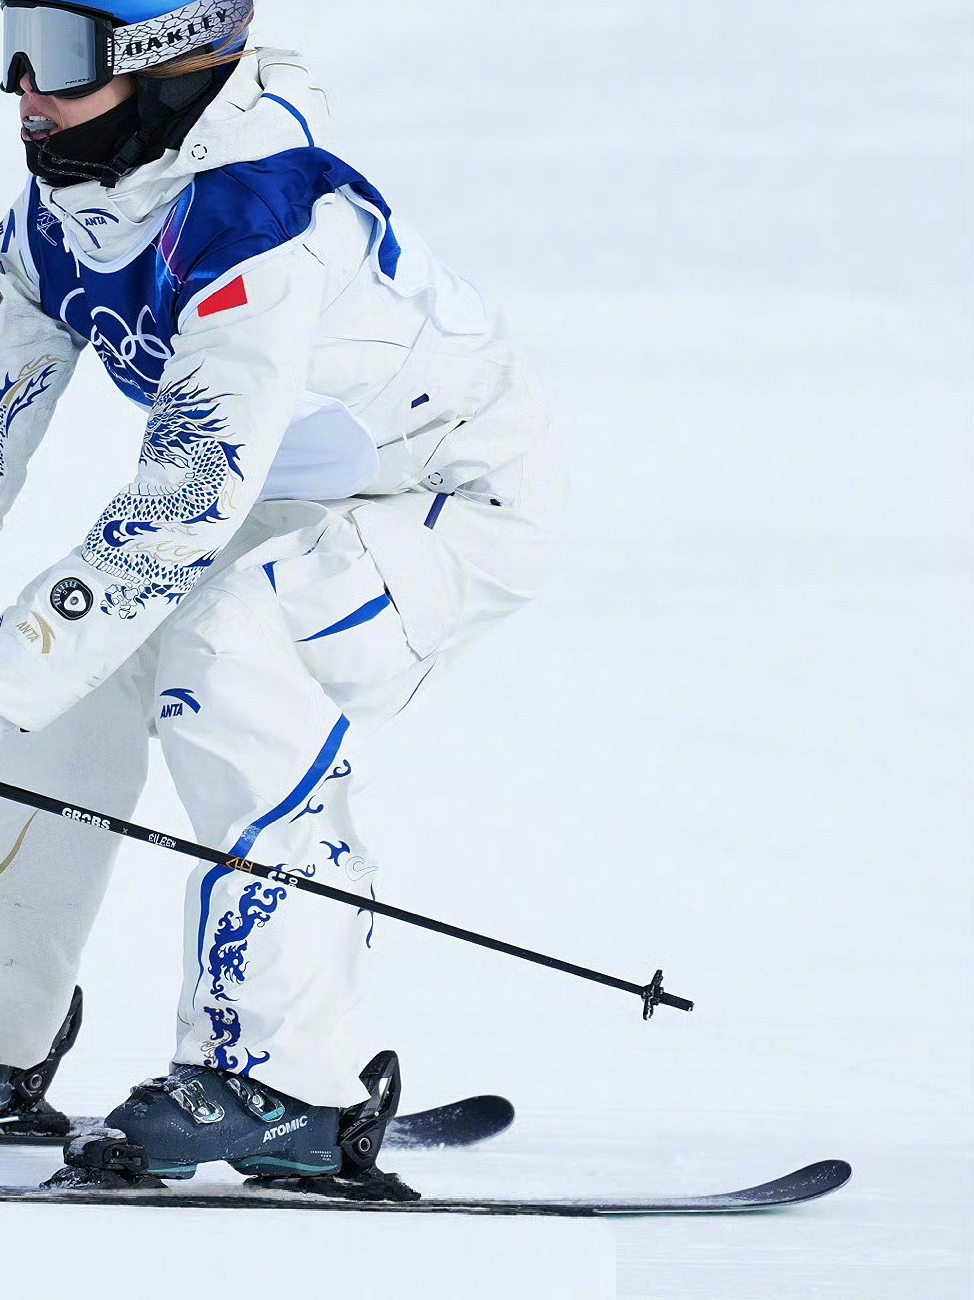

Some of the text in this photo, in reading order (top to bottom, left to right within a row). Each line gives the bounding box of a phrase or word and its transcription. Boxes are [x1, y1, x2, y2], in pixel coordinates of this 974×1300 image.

[125, 8, 228, 57] OAKLEY
[84, 216, 108, 226] ANTA
[15, 620, 40, 643] ANTA
[159, 702, 183, 719] ANTA
[262, 1115, 308, 1144] ATOMIC
